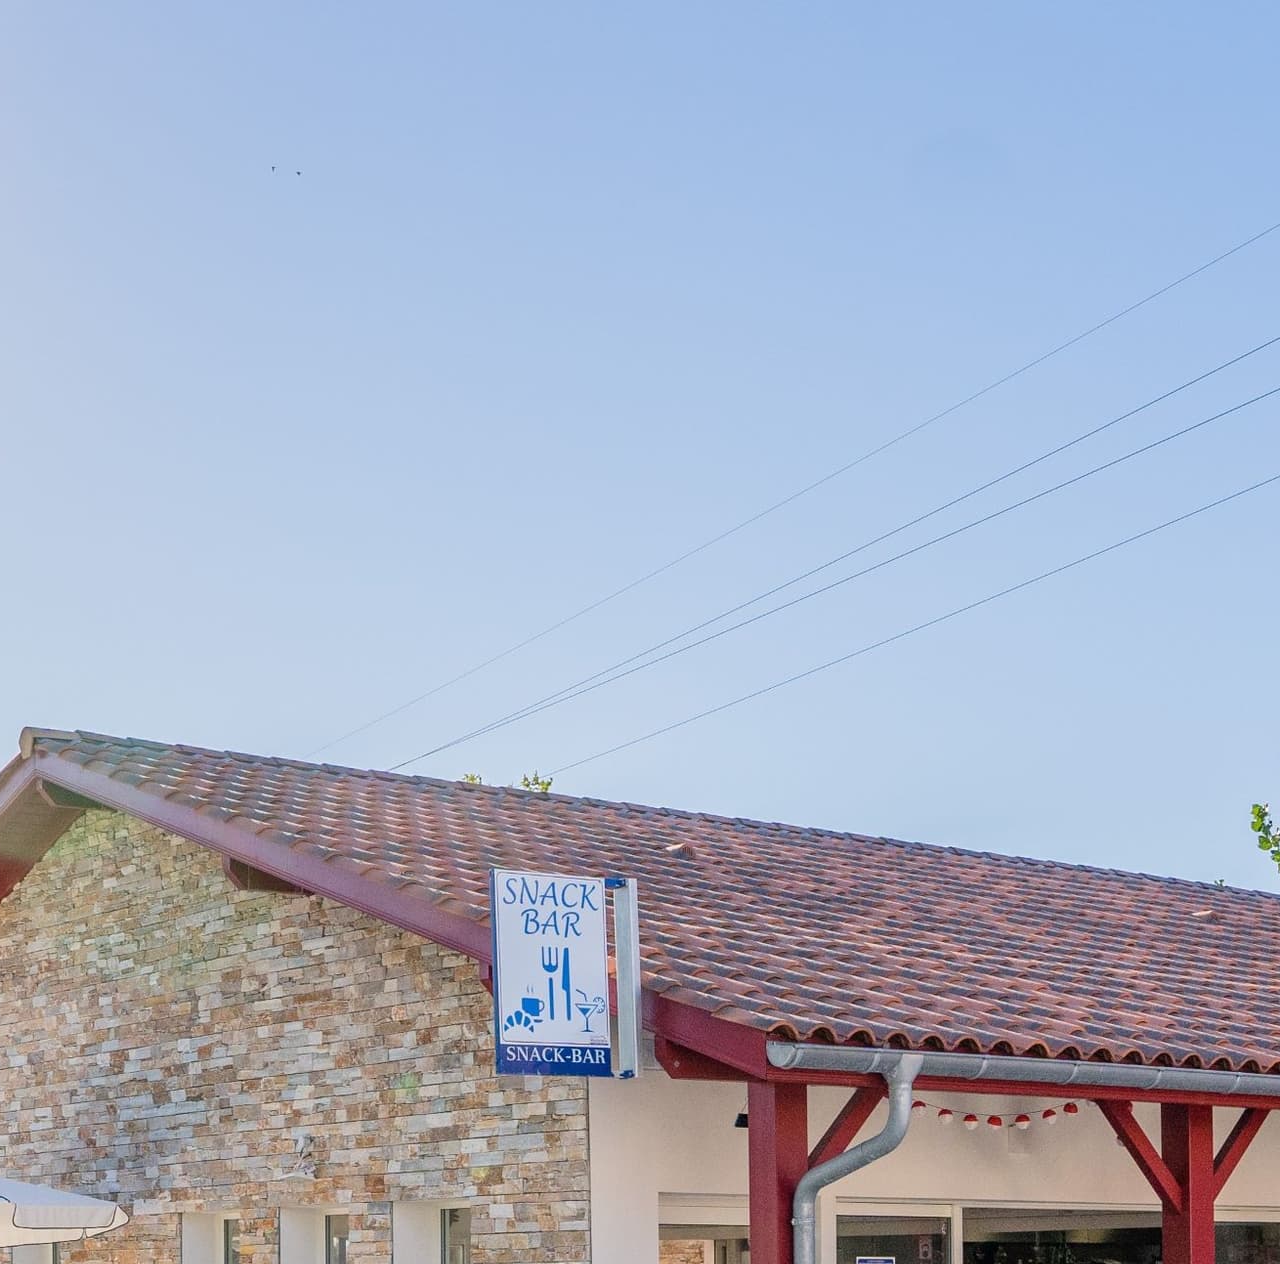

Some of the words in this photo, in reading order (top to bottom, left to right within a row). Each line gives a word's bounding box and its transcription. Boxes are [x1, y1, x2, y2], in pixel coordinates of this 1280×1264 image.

[503, 877, 599, 911] SNACK
[521, 908, 582, 938] BAR
[506, 1046, 606, 1064] SNACK-BAR
